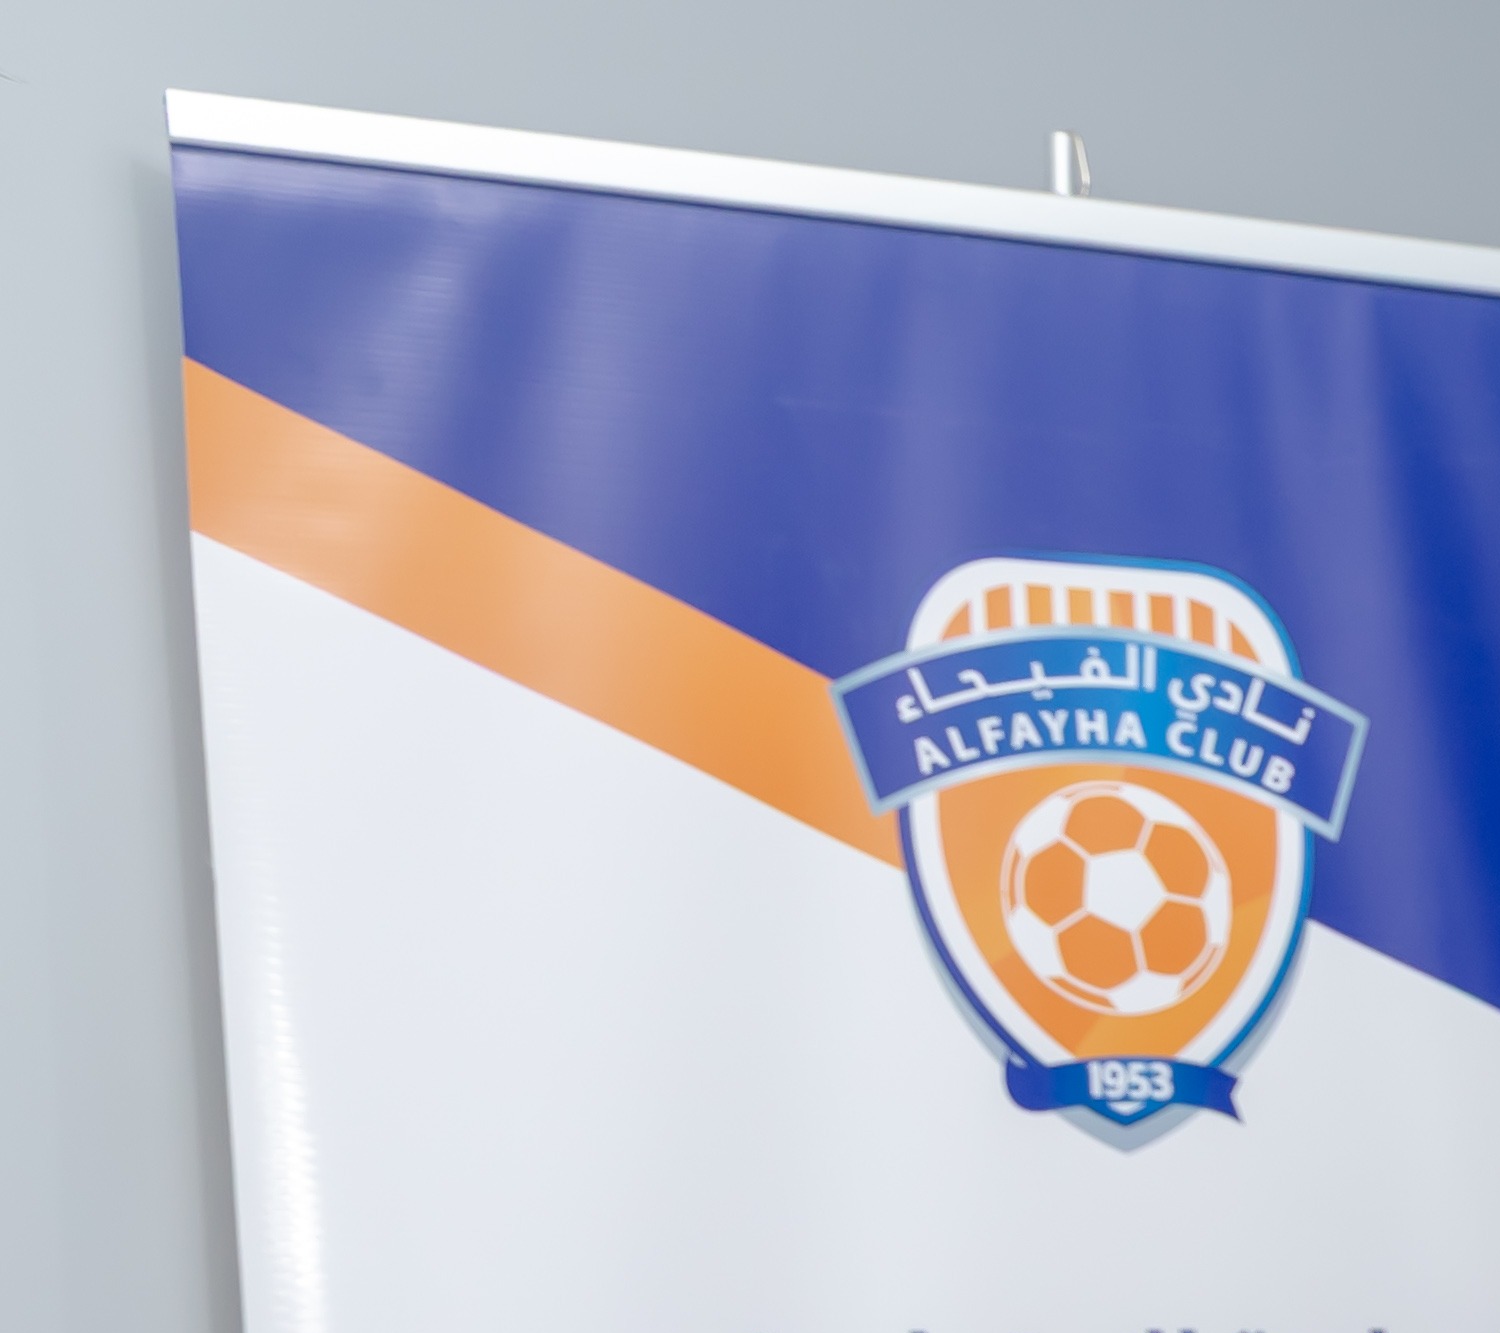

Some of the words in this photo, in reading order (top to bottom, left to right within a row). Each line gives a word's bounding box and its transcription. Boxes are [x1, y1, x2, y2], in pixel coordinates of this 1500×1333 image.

[895, 643, 1158, 724] الفيحاء
[1168, 672, 1316, 746] نادي
[912, 707, 1148, 777] ALFAYHA
[1164, 716, 1296, 794] CLUB
[1087, 1061, 1174, 1101] 1953
